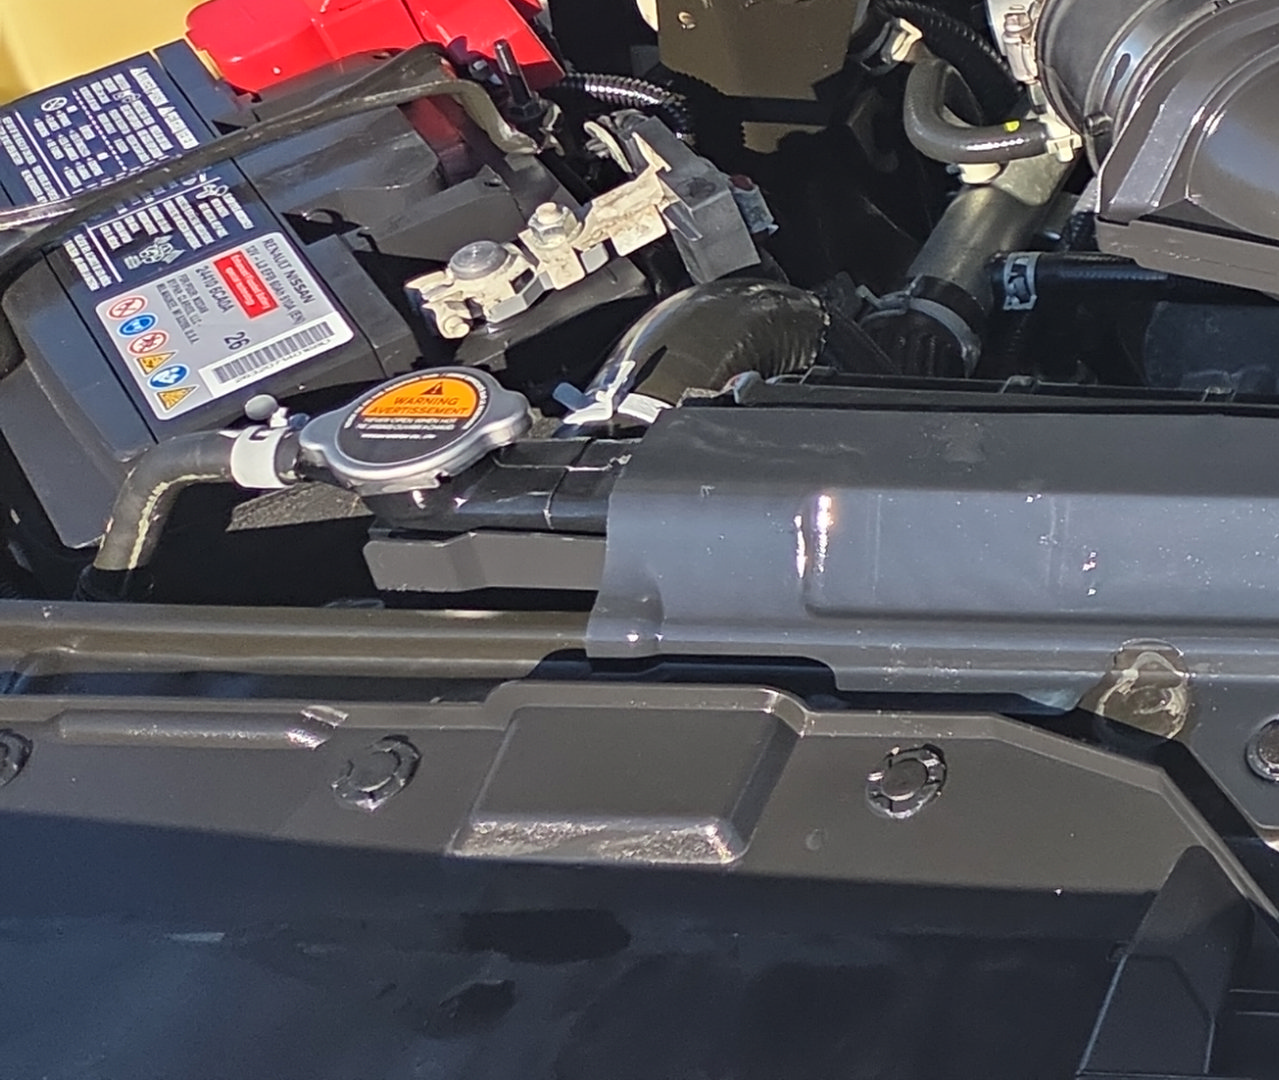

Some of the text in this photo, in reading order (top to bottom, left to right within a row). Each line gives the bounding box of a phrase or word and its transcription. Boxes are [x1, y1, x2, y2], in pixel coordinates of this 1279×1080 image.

[193, 264, 218, 288] 24410
[260, 237, 316, 304] RENAULT NISSAN
[243, 244, 260, 258] 12V
[285, 308, 307, 326] (EN)
[222, 330, 251, 352] 26
[394, 397, 459, 406] WARNING
